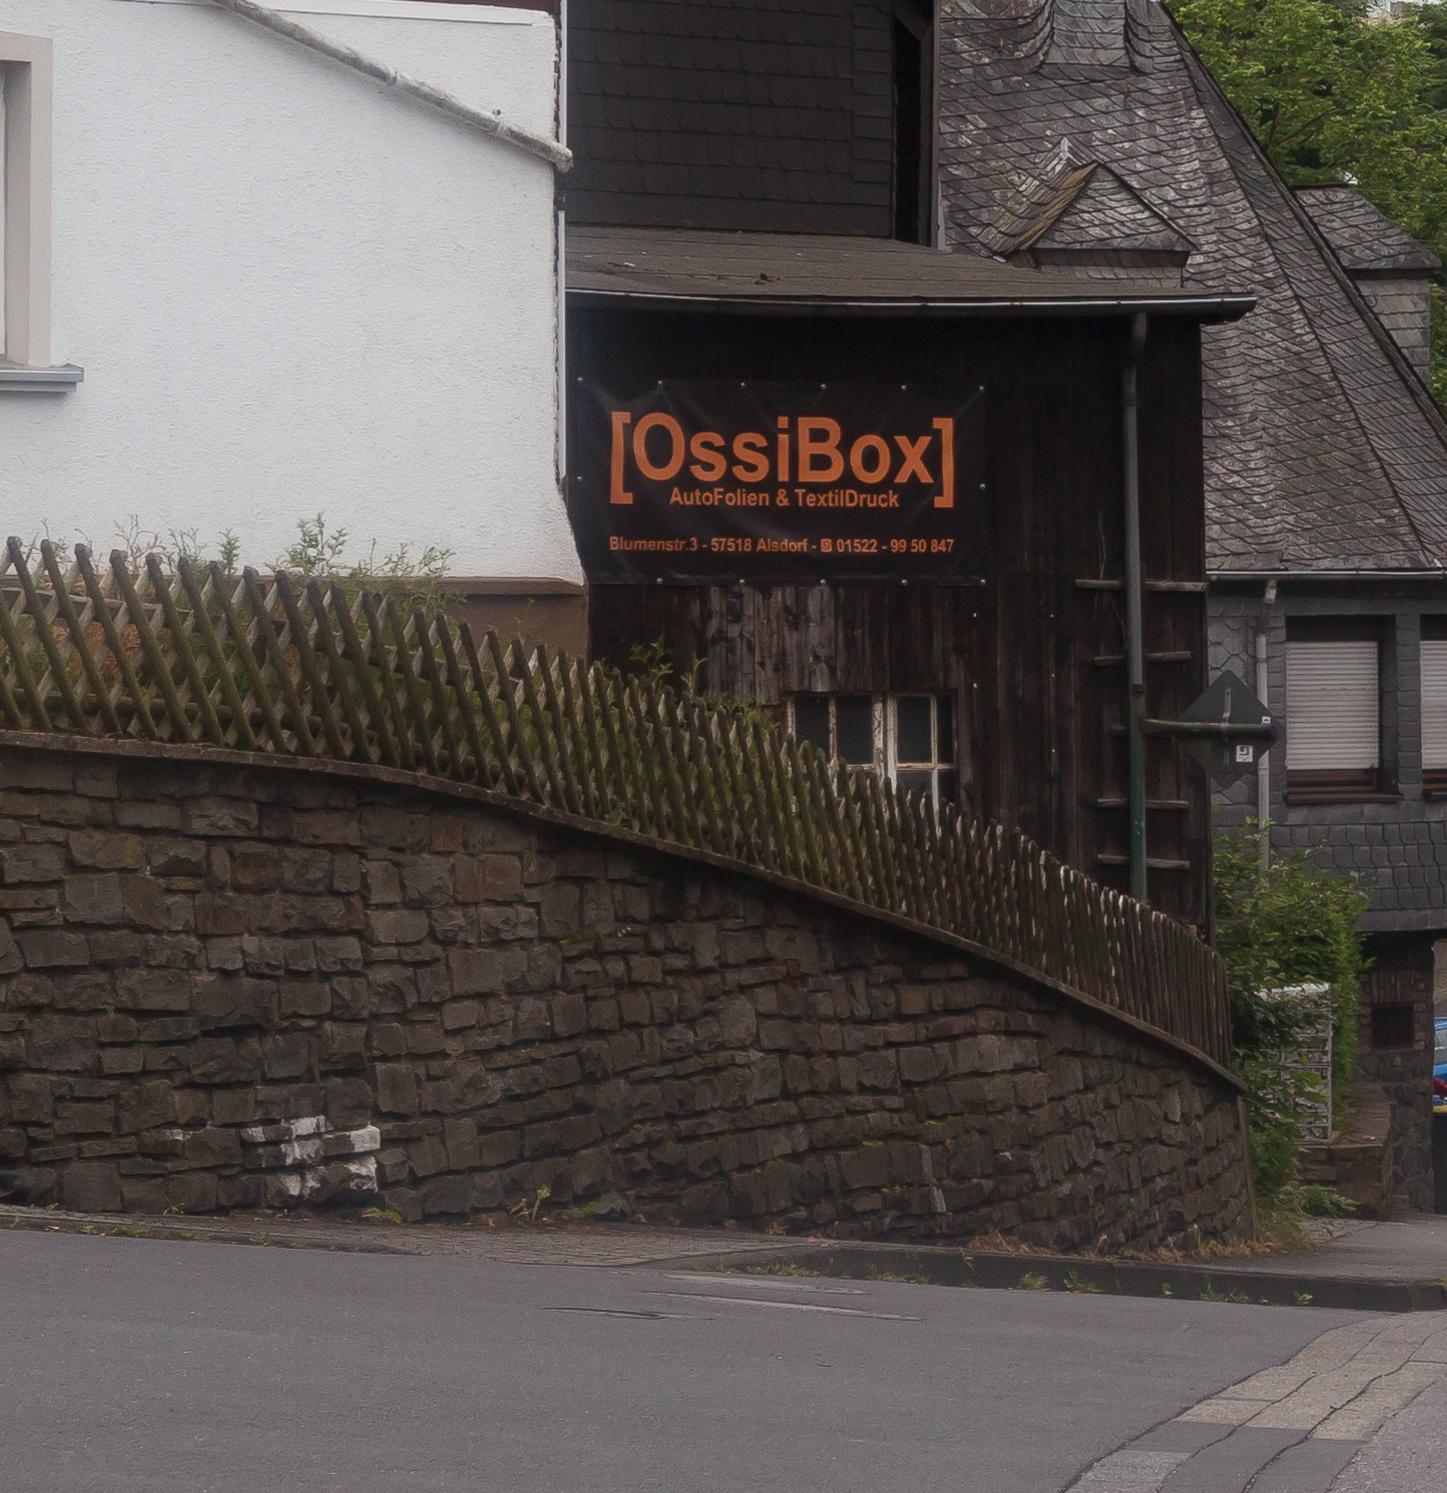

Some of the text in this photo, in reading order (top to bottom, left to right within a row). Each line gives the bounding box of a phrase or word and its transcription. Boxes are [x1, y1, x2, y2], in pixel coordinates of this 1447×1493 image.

[610, 411, 954, 508] [OssiBox]
[670, 487, 899, 507] AutoFolien & TextilDruck
[711, 538, 752, 552] 57518
[756, 538, 808, 552] Alsdorf
[836, 538, 877, 553] 01522
[890, 539, 907, 553] 99
[910, 539, 927, 553] 50
[930, 538, 954, 553] 847
